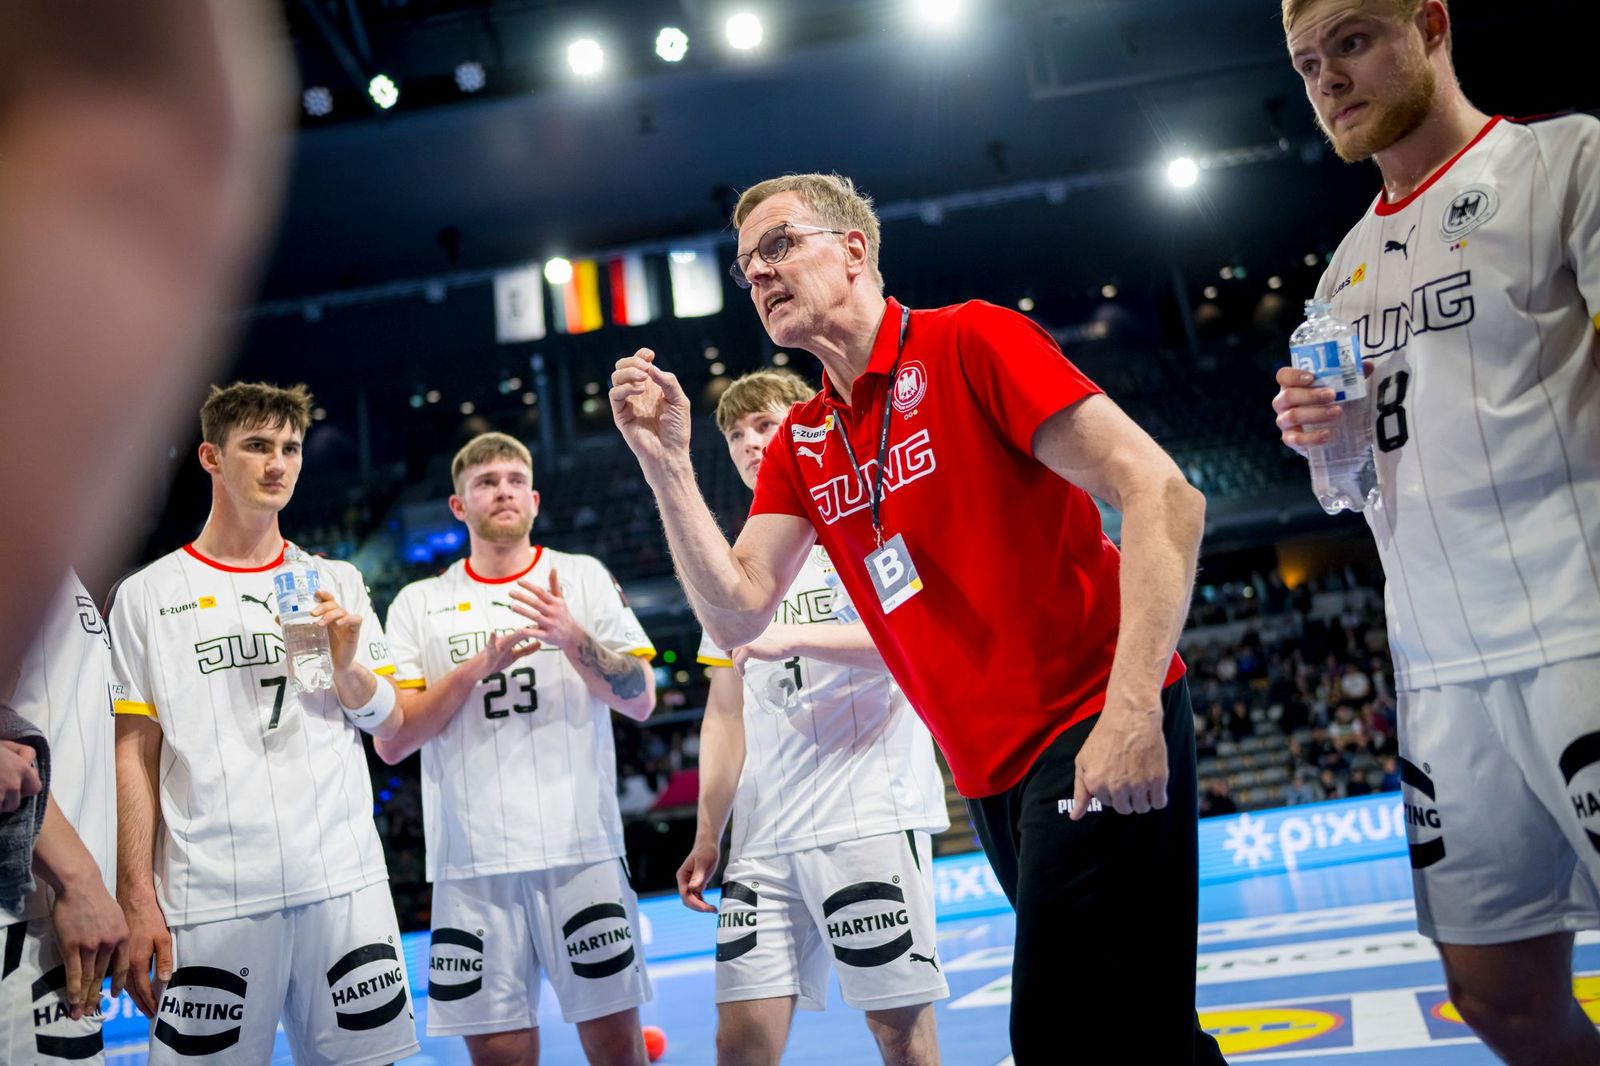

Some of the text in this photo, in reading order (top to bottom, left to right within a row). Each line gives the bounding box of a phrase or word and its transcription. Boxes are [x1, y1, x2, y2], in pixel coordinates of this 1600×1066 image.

[1352, 270, 1475, 360] UNG
[1376, 370, 1409, 453] 8
[809, 428, 937, 525] JUNG
[872, 547, 905, 589] B
[260, 676, 288, 730] 7
[482, 666, 538, 719] 23
[1058, 797, 1102, 814] PUA
[566, 924, 632, 958] HARTING
[827, 908, 910, 940] HARTING
[160, 995, 245, 1021] HARTING
[331, 966, 403, 1008] HARTING
